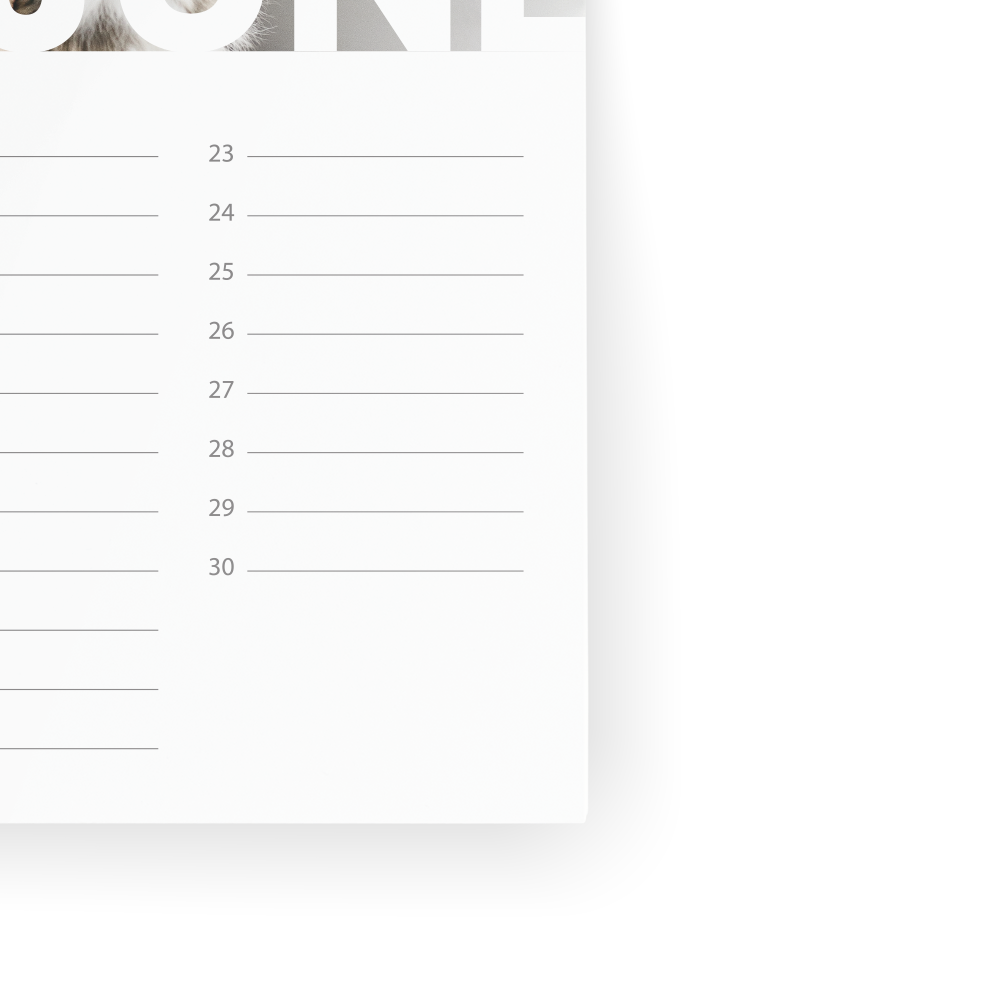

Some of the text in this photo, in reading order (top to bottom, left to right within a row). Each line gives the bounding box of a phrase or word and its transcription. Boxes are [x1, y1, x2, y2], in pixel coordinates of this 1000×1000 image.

[208, 143, 234, 163] 23
[208, 203, 235, 222] 24
[208, 262, 234, 281] 25
[208, 321, 235, 340] 26
[208, 380, 235, 399] 27
[208, 439, 235, 458] 28
[208, 498, 235, 517] 29
[208, 557, 235, 576] 30
